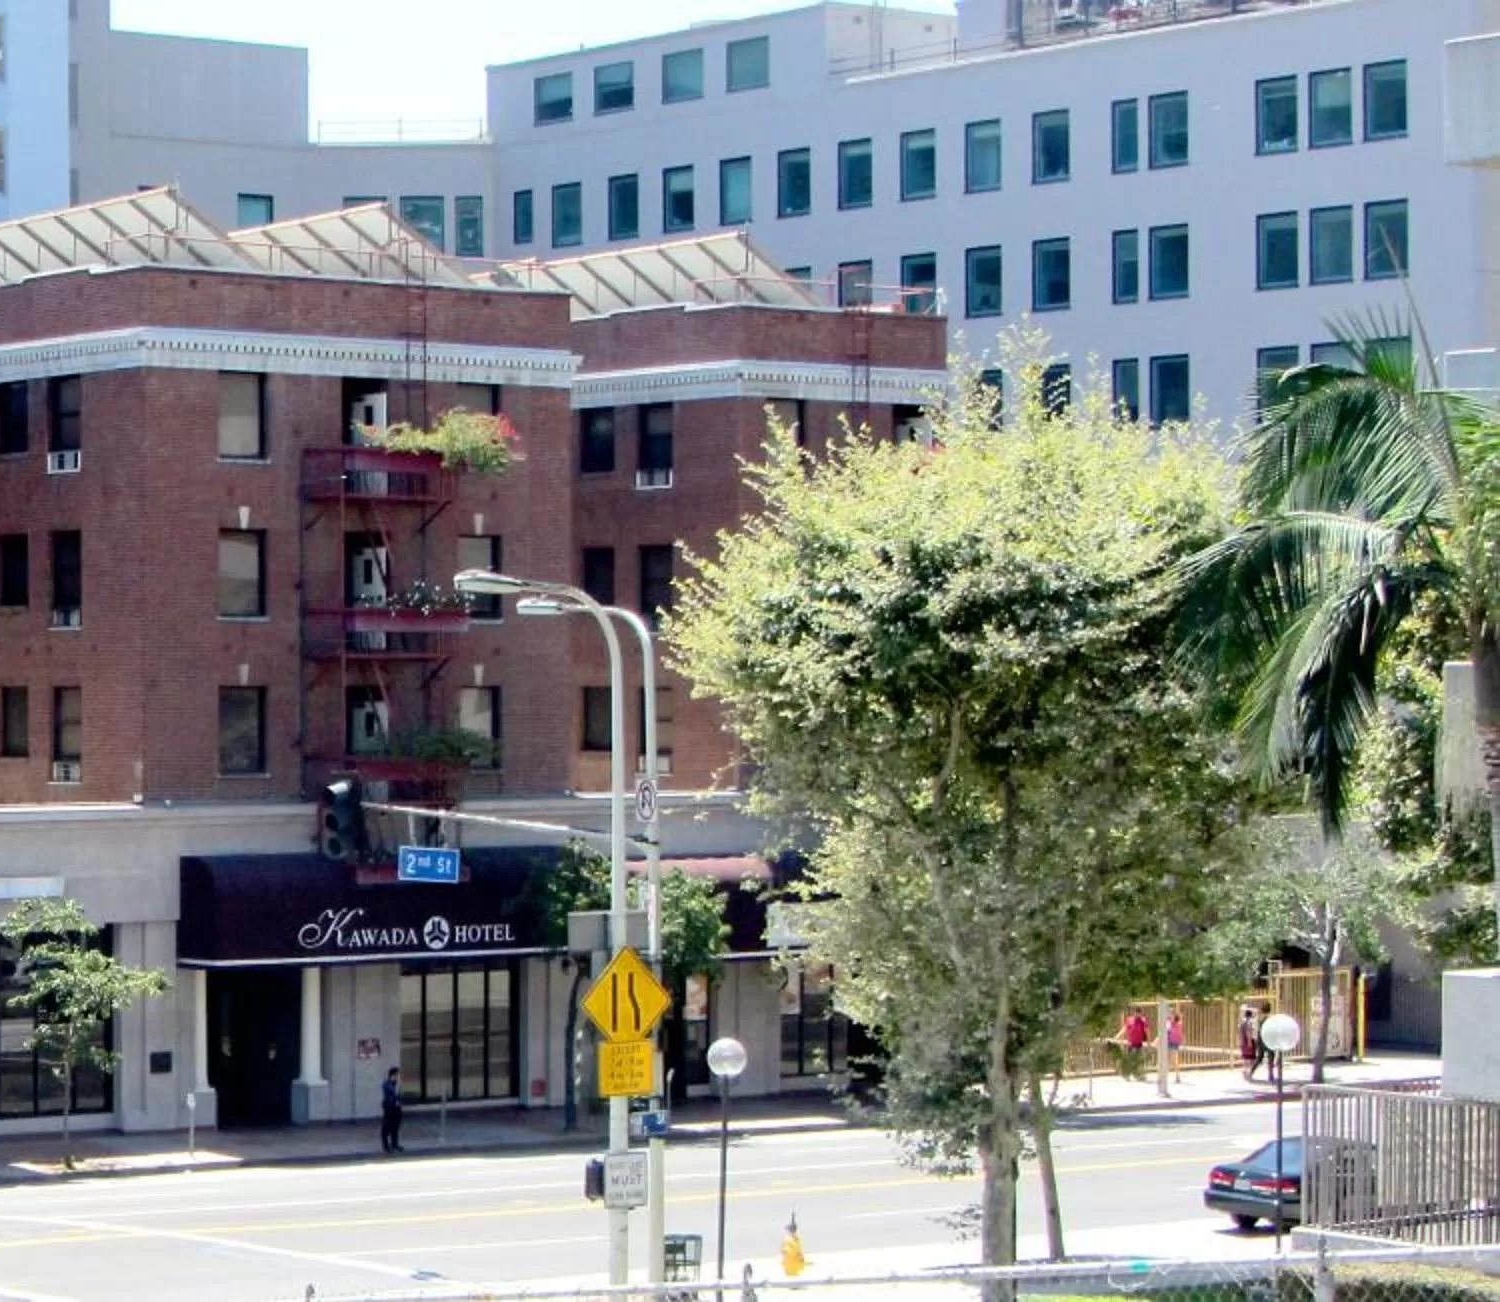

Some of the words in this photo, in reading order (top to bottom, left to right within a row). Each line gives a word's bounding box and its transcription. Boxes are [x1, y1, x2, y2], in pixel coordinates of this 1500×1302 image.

[406, 853, 431, 874] 2nd
[436, 855, 453, 875] St
[297, 907, 419, 949] KAWADA
[454, 923, 516, 943] HOTEL
